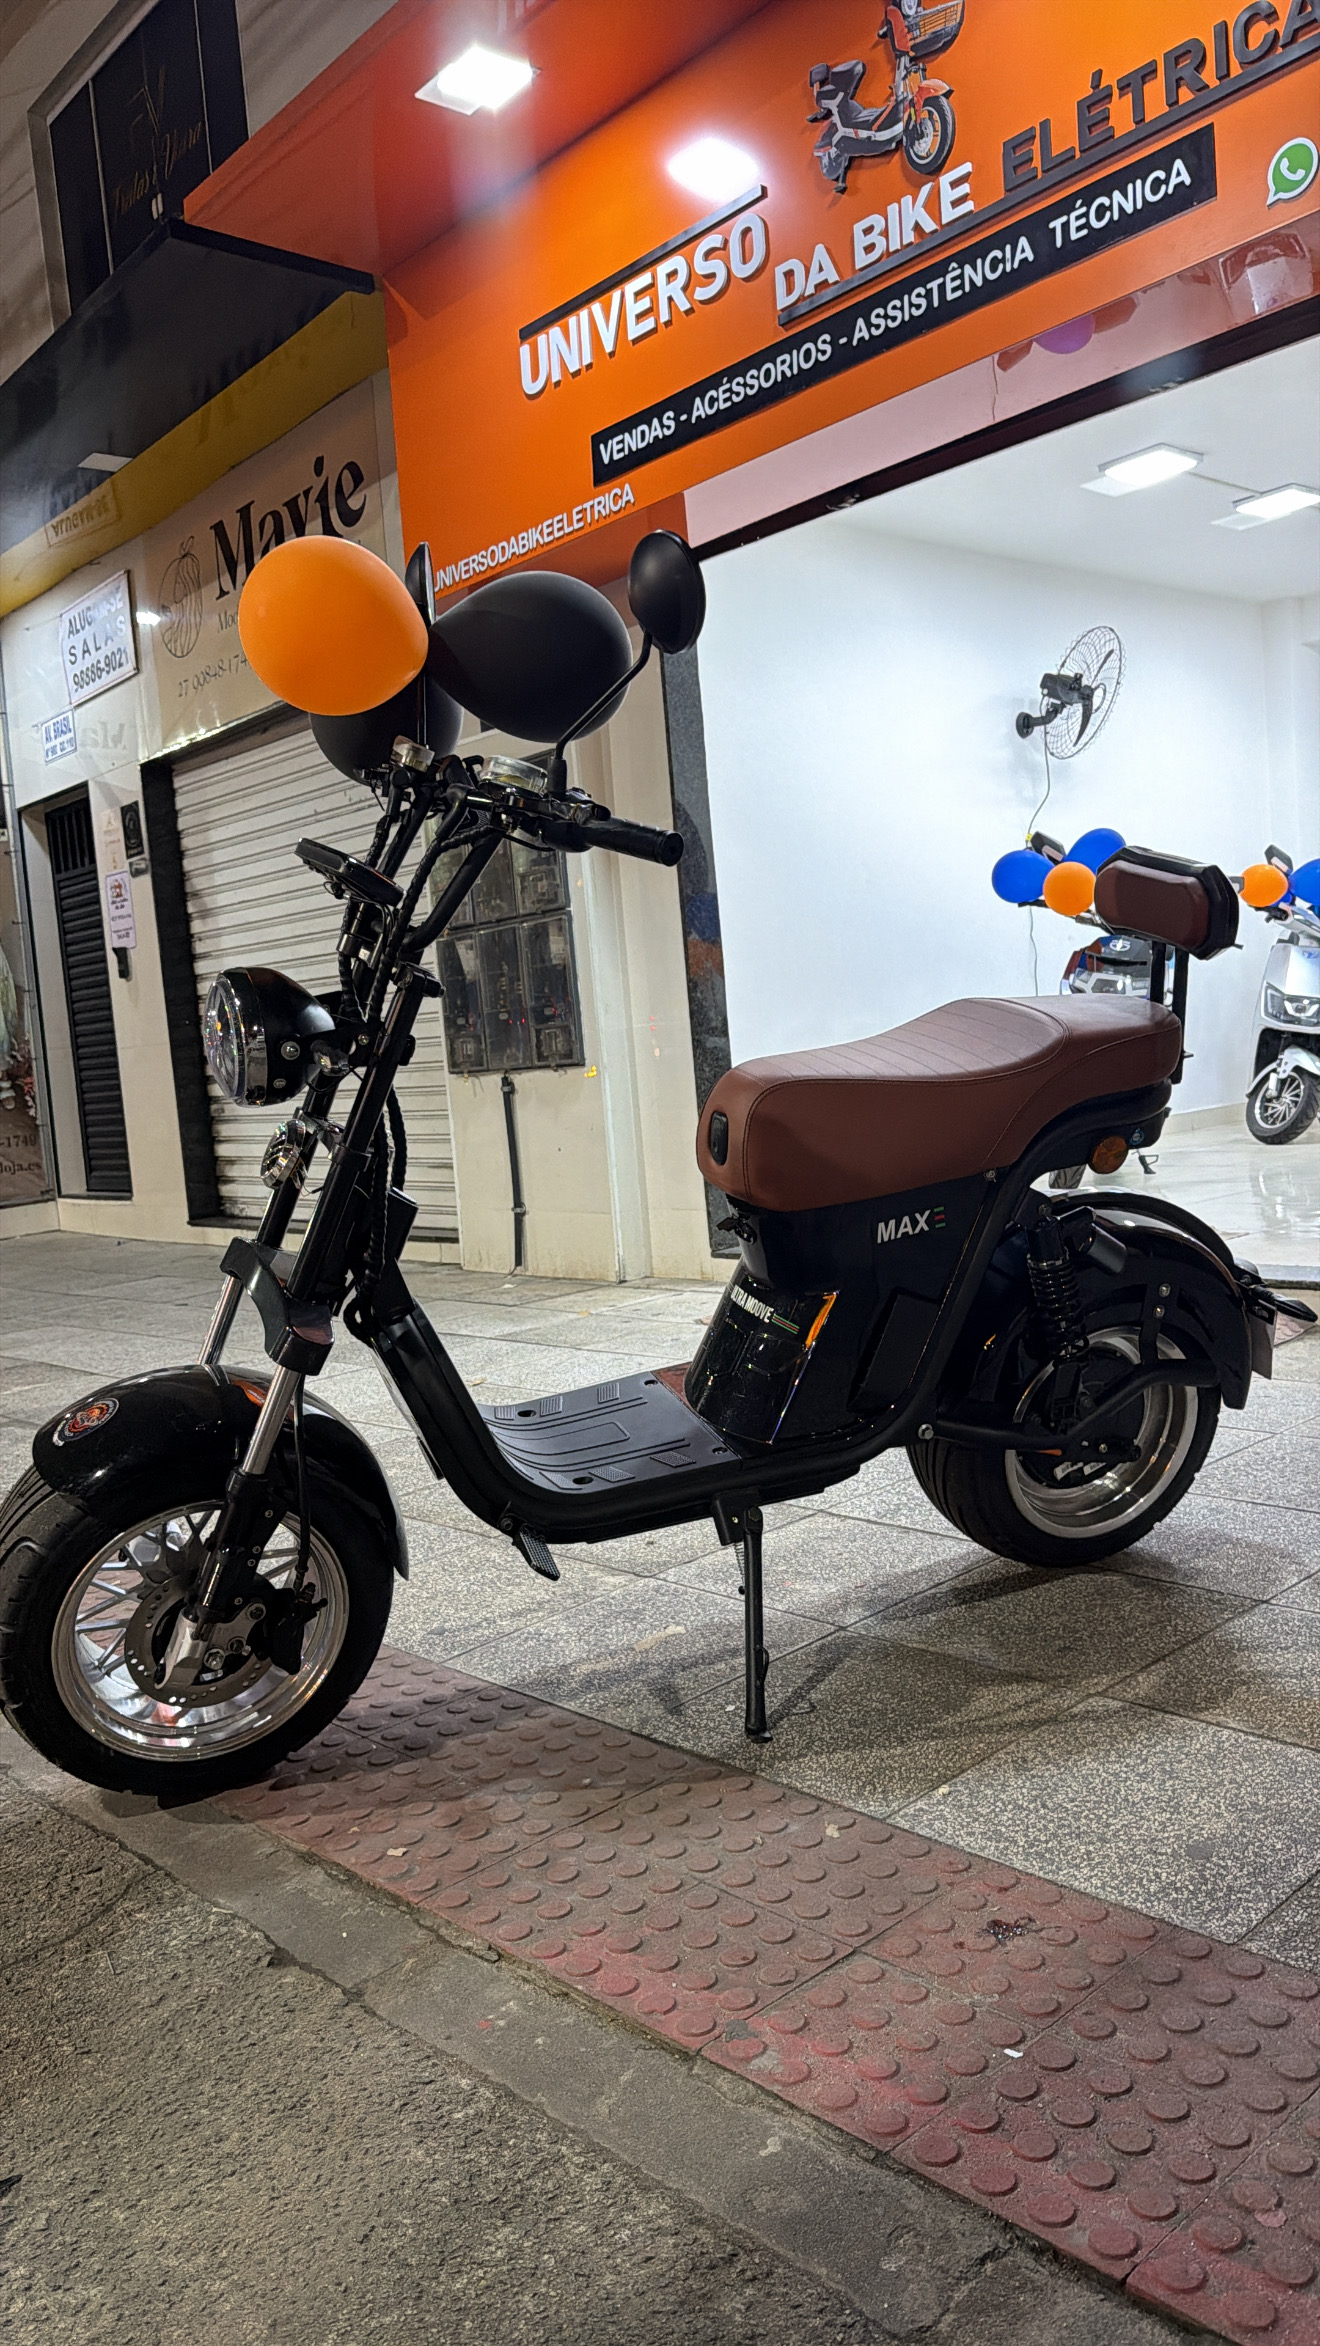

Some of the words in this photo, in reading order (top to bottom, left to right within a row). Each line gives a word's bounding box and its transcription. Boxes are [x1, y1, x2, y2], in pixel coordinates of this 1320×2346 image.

[775, 243, 841, 311] DA
[853, 161, 975, 270] BIKE
[1002, 0, 1320, 193] ELÉTRICA
[519, 212, 769, 397] UNIVERSO
[599, 410, 676, 465] VENDAS
[691, 333, 833, 424] ACÉSSORIOS
[852, 235, 1035, 347] ASSISTÊNCIA
[1048, 158, 1192, 249] TÉCNICA
[209, 455, 367, 600] Mavie
[68, 615, 127, 665] SALAS
[744, 1295, 774, 1323] MOOVE
